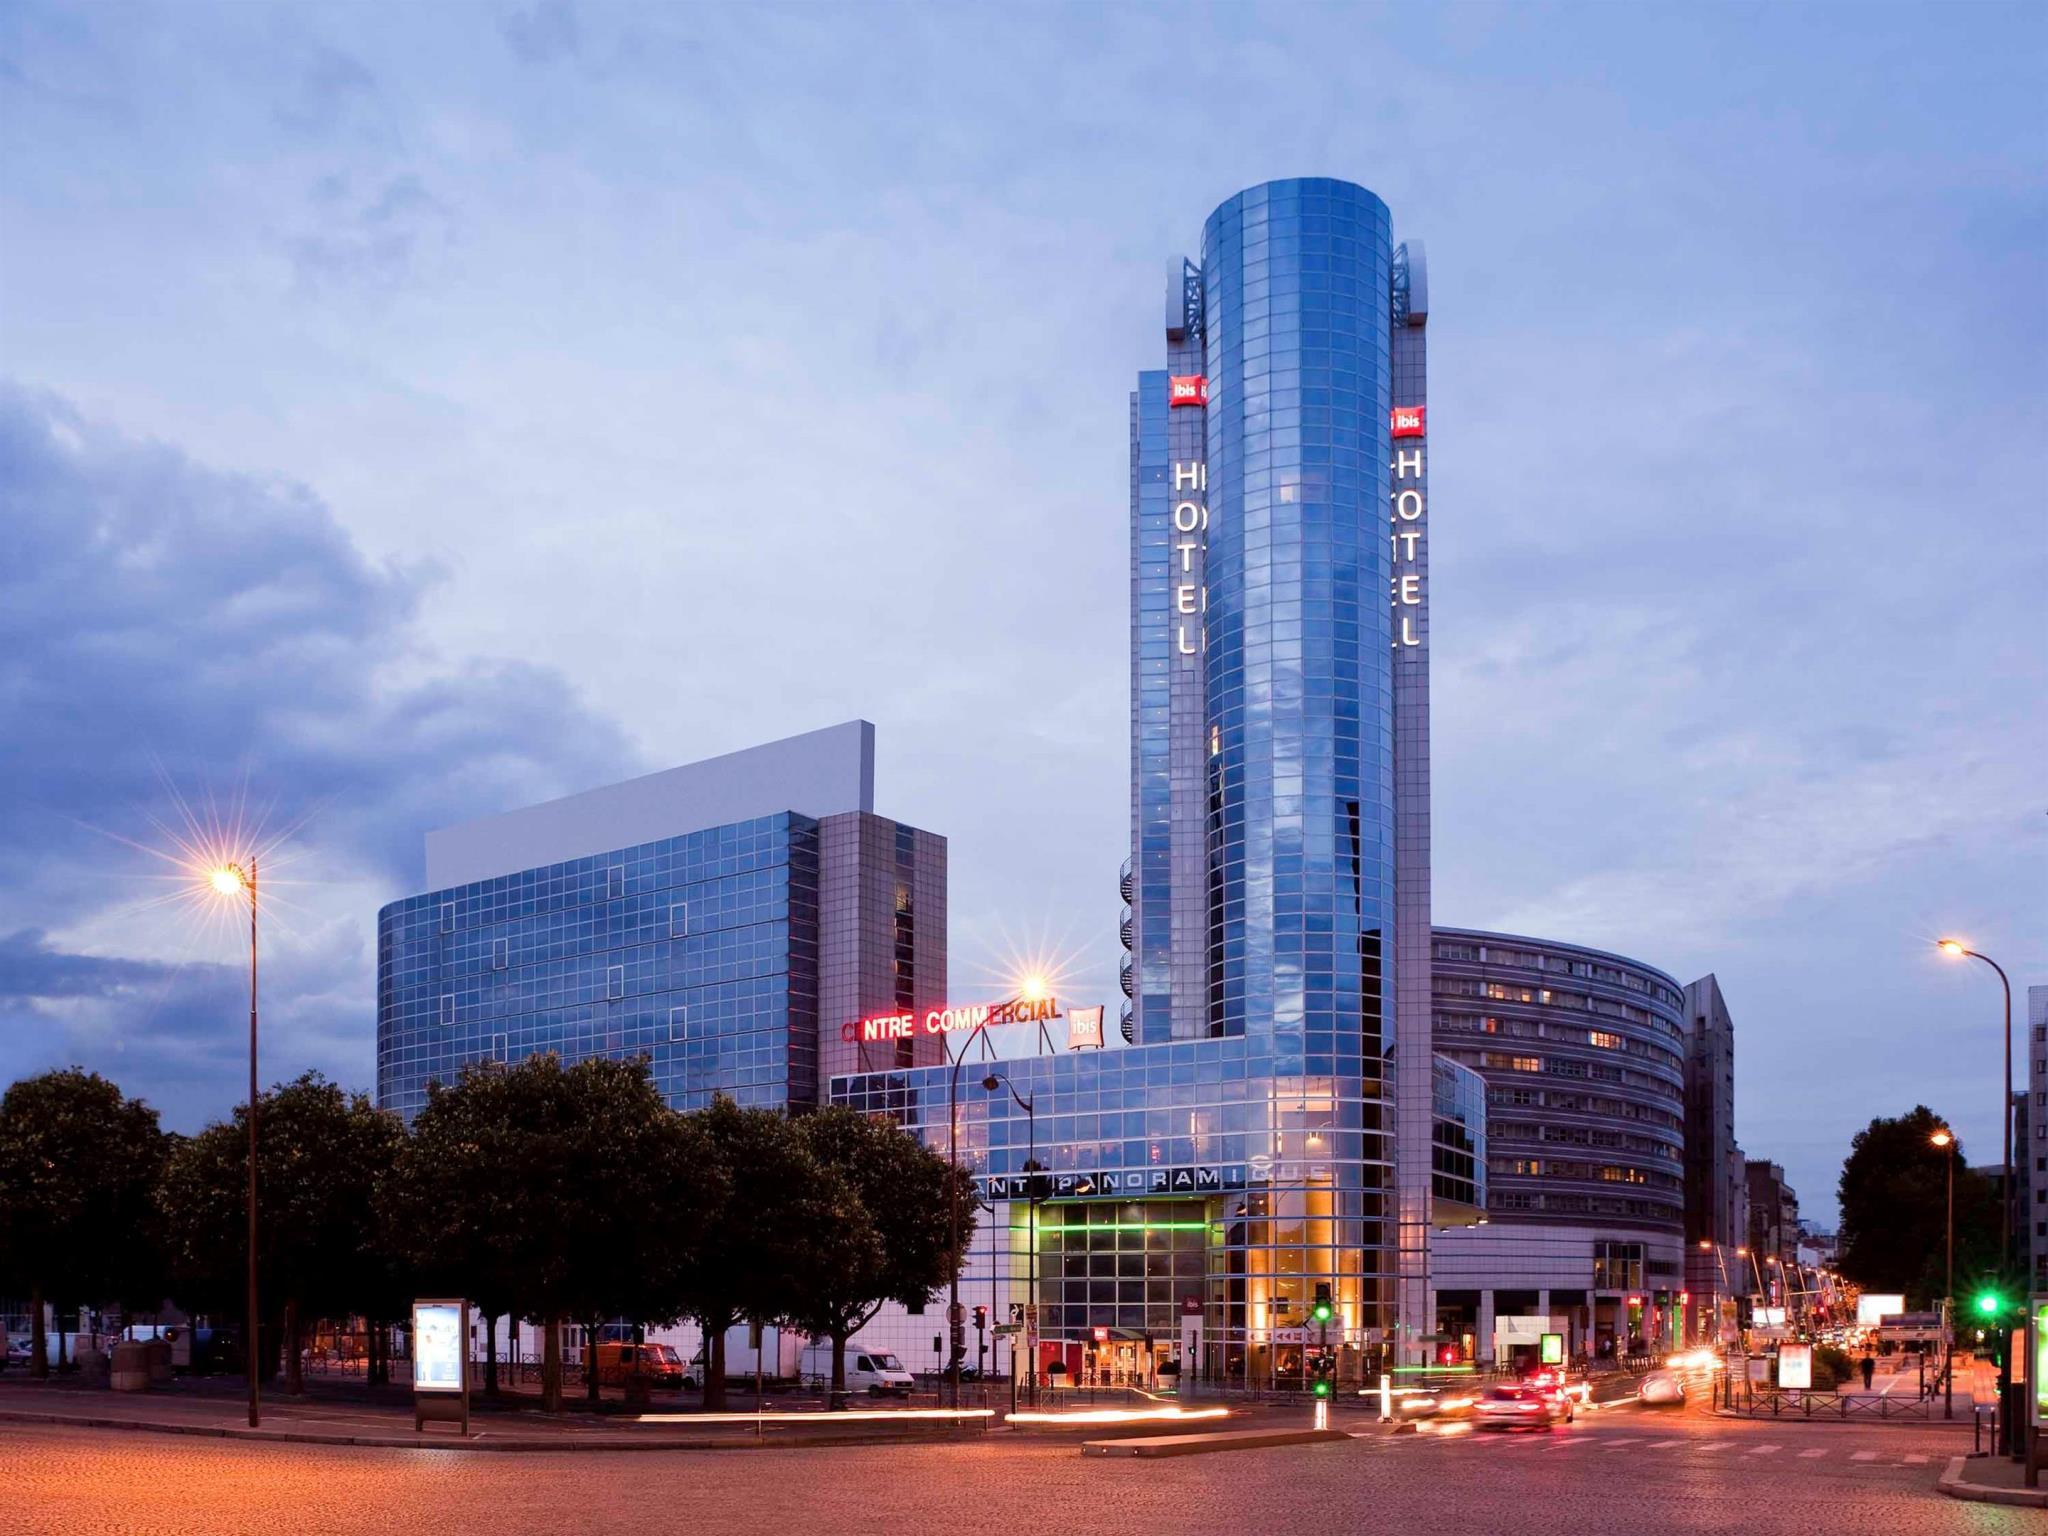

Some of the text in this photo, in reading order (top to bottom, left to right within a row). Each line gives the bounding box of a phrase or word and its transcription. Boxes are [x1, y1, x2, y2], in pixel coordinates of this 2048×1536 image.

[1174, 384, 1196, 397] ibis
[1397, 415, 1420, 428] ibis
[1174, 462, 1198, 654] HOTEL
[1397, 450, 1422, 646] HOTEL
[926, 997, 1063, 1034] COMMERCIAL
[1072, 1021, 1097, 1034] ibis
